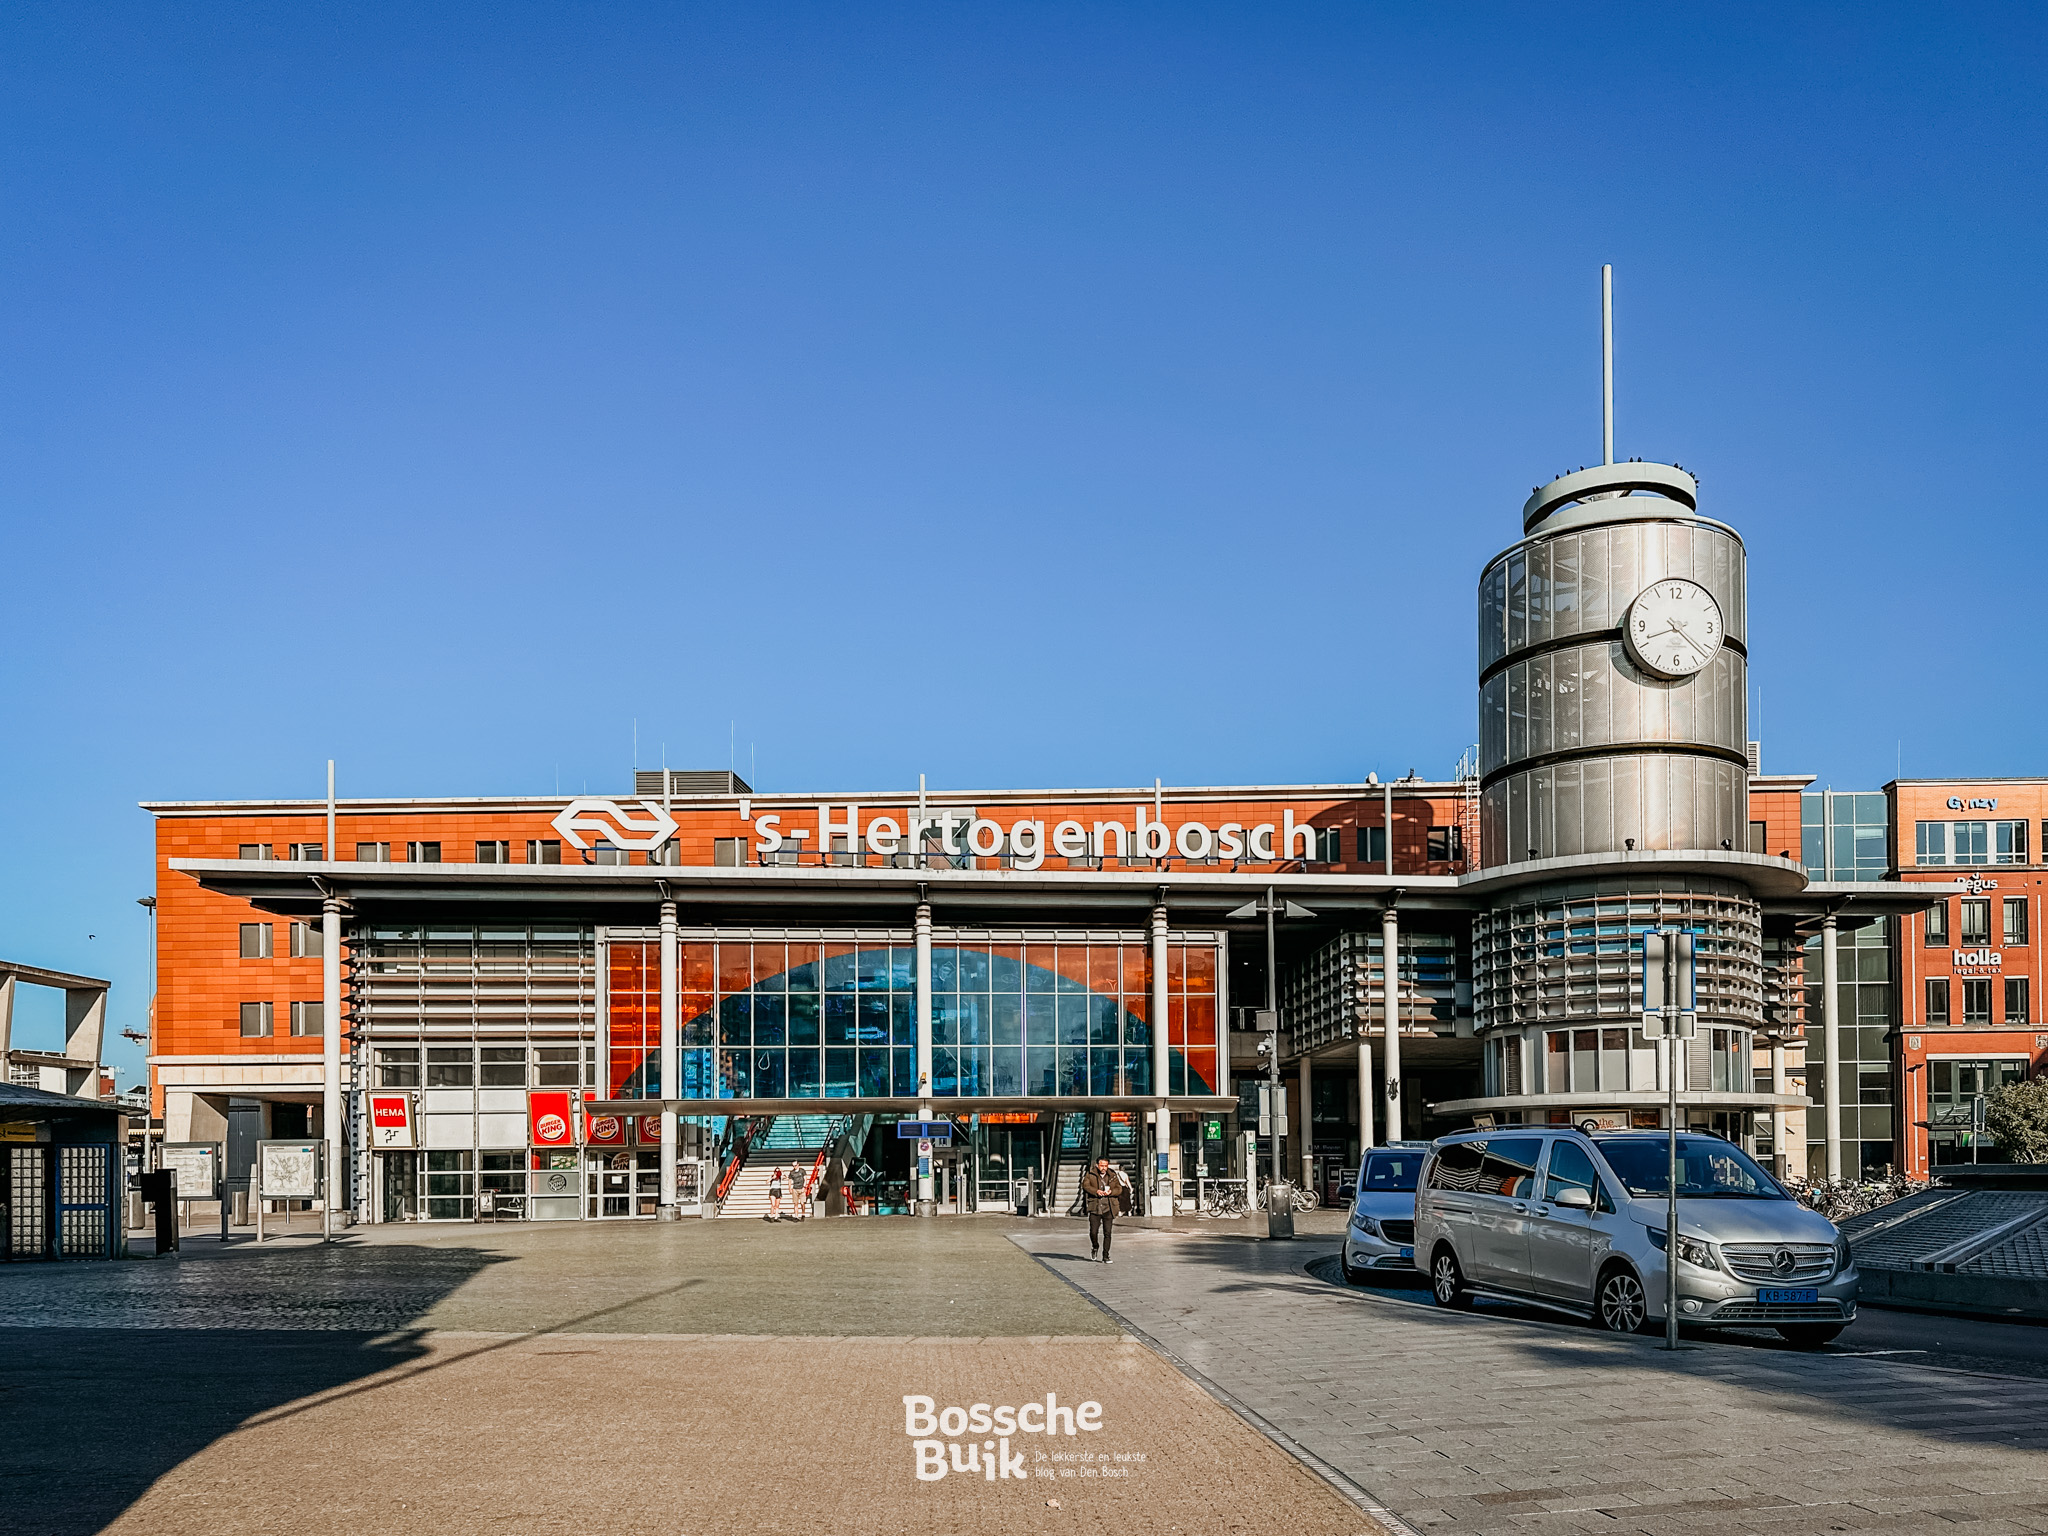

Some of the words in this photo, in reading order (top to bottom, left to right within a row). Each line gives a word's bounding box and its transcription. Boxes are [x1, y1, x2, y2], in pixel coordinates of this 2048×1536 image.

[1669, 587, 1682, 600] 12
[1638, 620, 1646, 632] 9
[1706, 622, 1713, 634] 3
[1673, 654, 1680, 667] 6
[1948, 795, 1999, 811] Gynzy
[739, 798, 1318, 870] 's-Hertogenbosch
[1953, 948, 2002, 966] holla
[1953, 967, 1976, 975] legal
[375, 1108, 405, 1117] HEMA
[540, 1119, 562, 1129] BURGER
[595, 1118, 615, 1127] BURGER
[1598, 1117, 1614, 1126] the
[541, 1124, 563, 1135] KING
[595, 1124, 616, 1135] KING
[647, 1123, 661, 1134] KIN
[1765, 1291, 1811, 1301] KB-587-F
